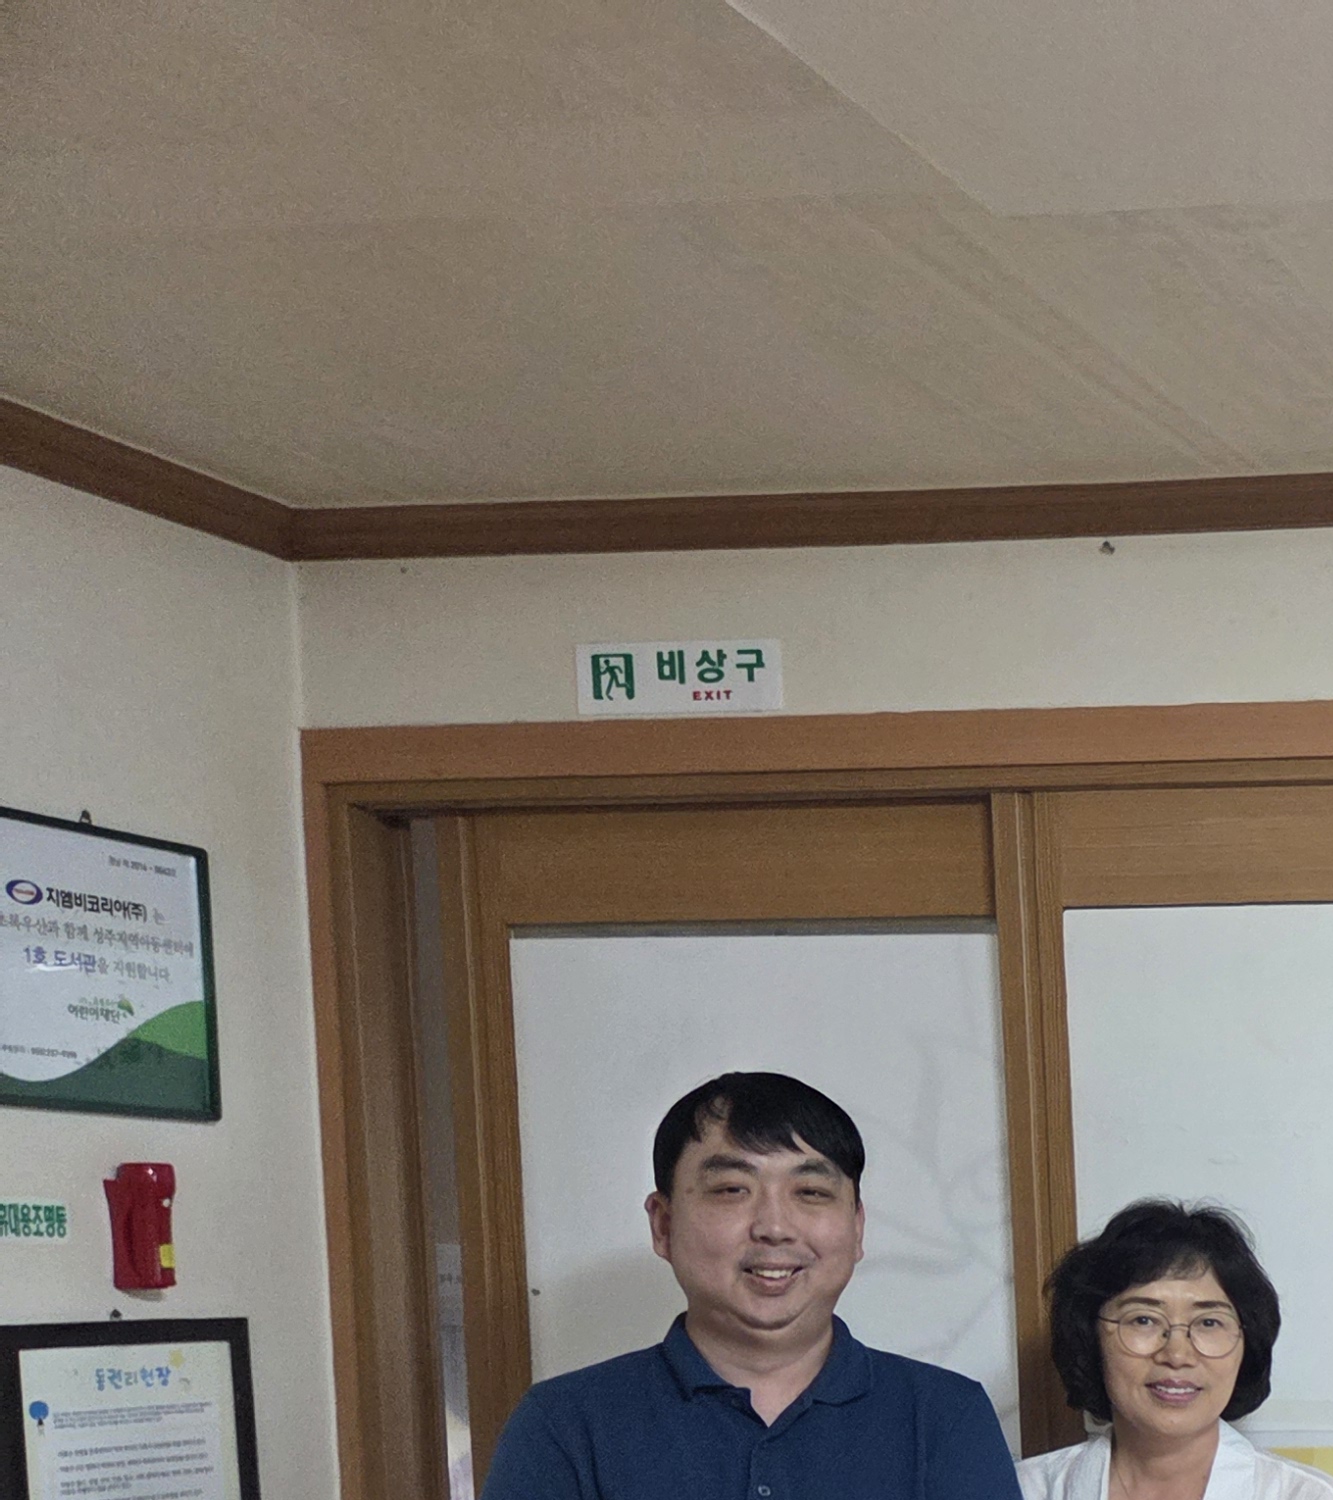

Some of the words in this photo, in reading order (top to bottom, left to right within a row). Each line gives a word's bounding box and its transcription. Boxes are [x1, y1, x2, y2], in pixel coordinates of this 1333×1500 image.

[656, 648, 765, 684] 비상구
[692, 690, 732, 701] EXIT
[46, 887, 148, 923] 지엠비코리아(주)
[23, 946, 47, 965] 1호
